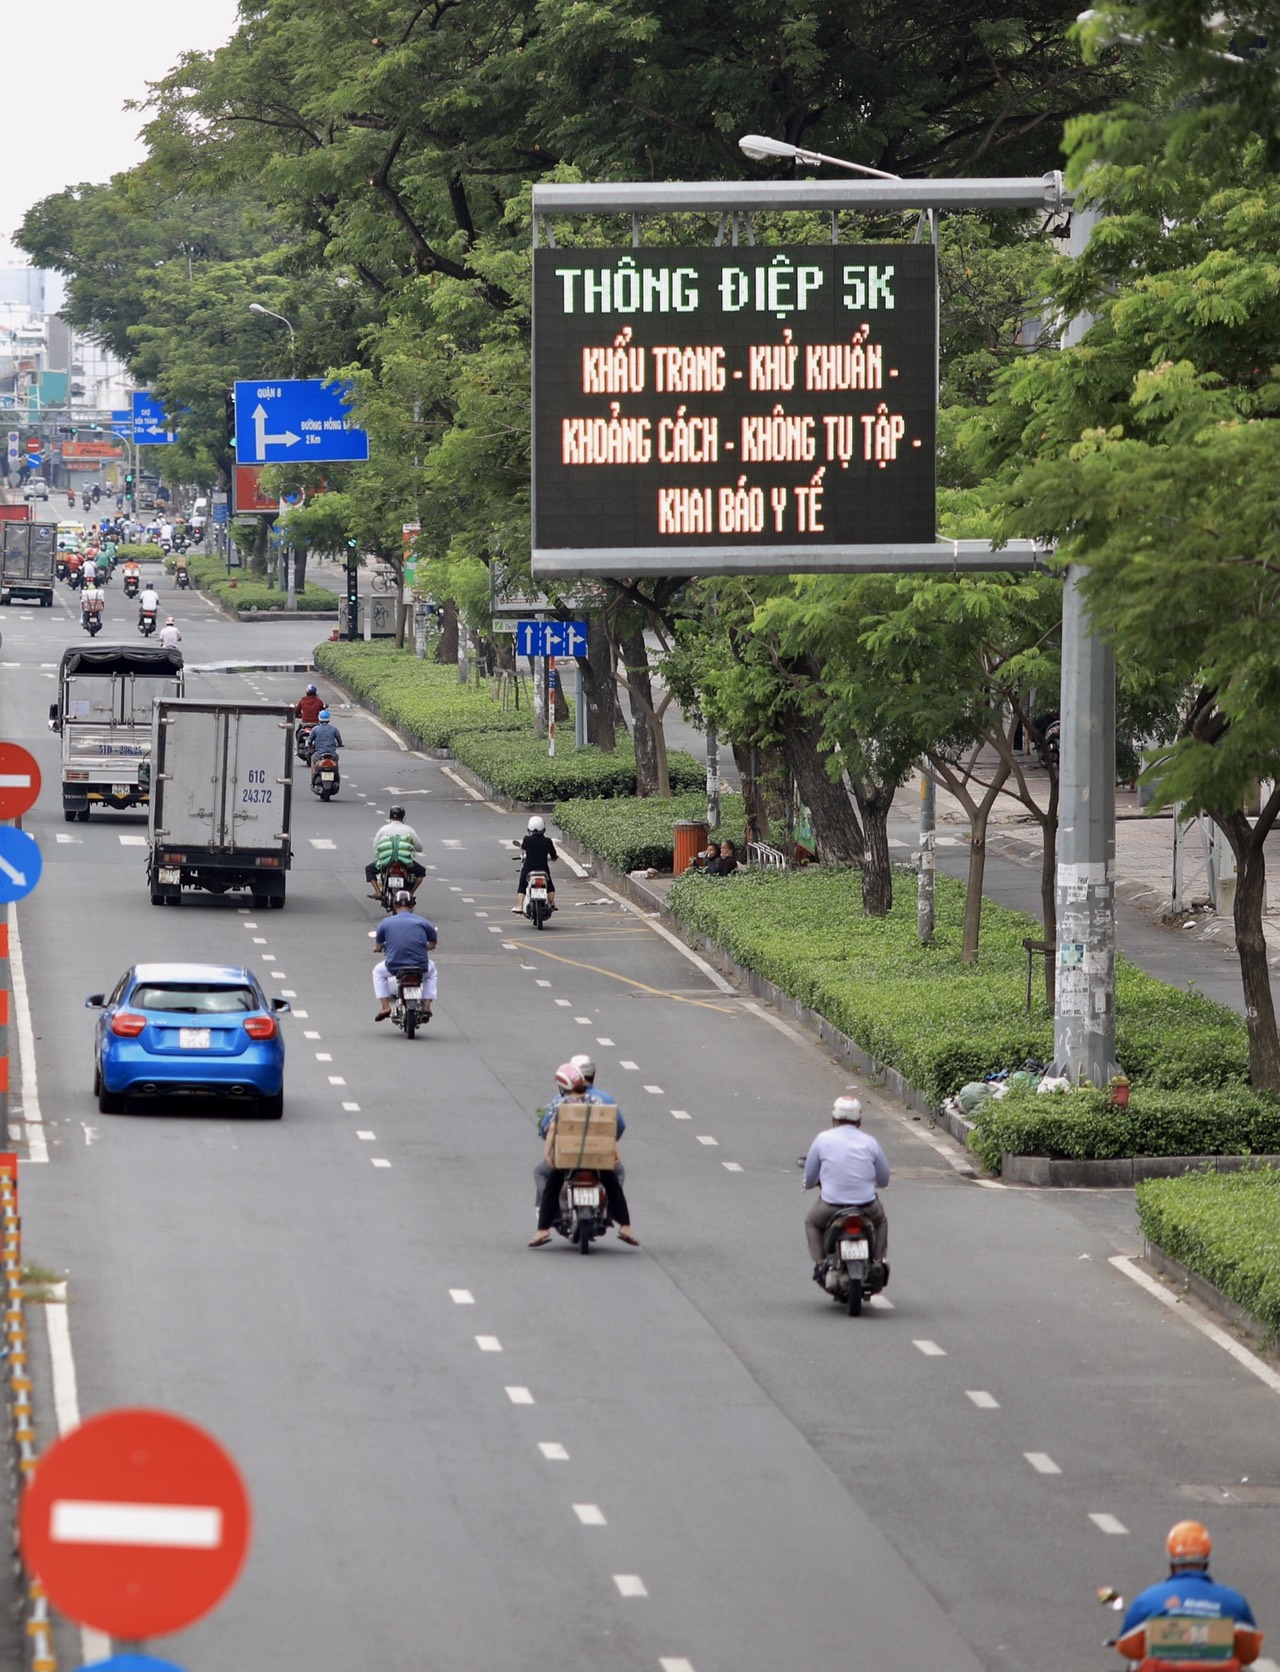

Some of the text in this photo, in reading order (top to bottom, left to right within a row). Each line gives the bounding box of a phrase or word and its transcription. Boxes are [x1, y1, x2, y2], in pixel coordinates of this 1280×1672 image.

[555, 254, 895, 319] THÔNG ĐIỆP 5K
[582, 326, 645, 393] KHẨU
[652, 346, 726, 392] TRANG
[749, 328, 799, 391] KHỬ
[805, 323, 883, 390] KHUẨN
[257, 386, 282, 400] QUẬN 8
[301, 418, 323, 431] ĐƯỜNG
[561, 401, 652, 464] KHOẢNG
[657, 405, 718, 463] CÁCH
[741, 404, 816, 462] KHÔNG
[823, 416, 853, 468] TỤ
[860, 403, 905, 468] TẬP
[658, 466, 826, 533] KHAI BÁO Y TẾ
[242, 788, 272, 804] 243.72
[248, 769, 265, 784] 61C
